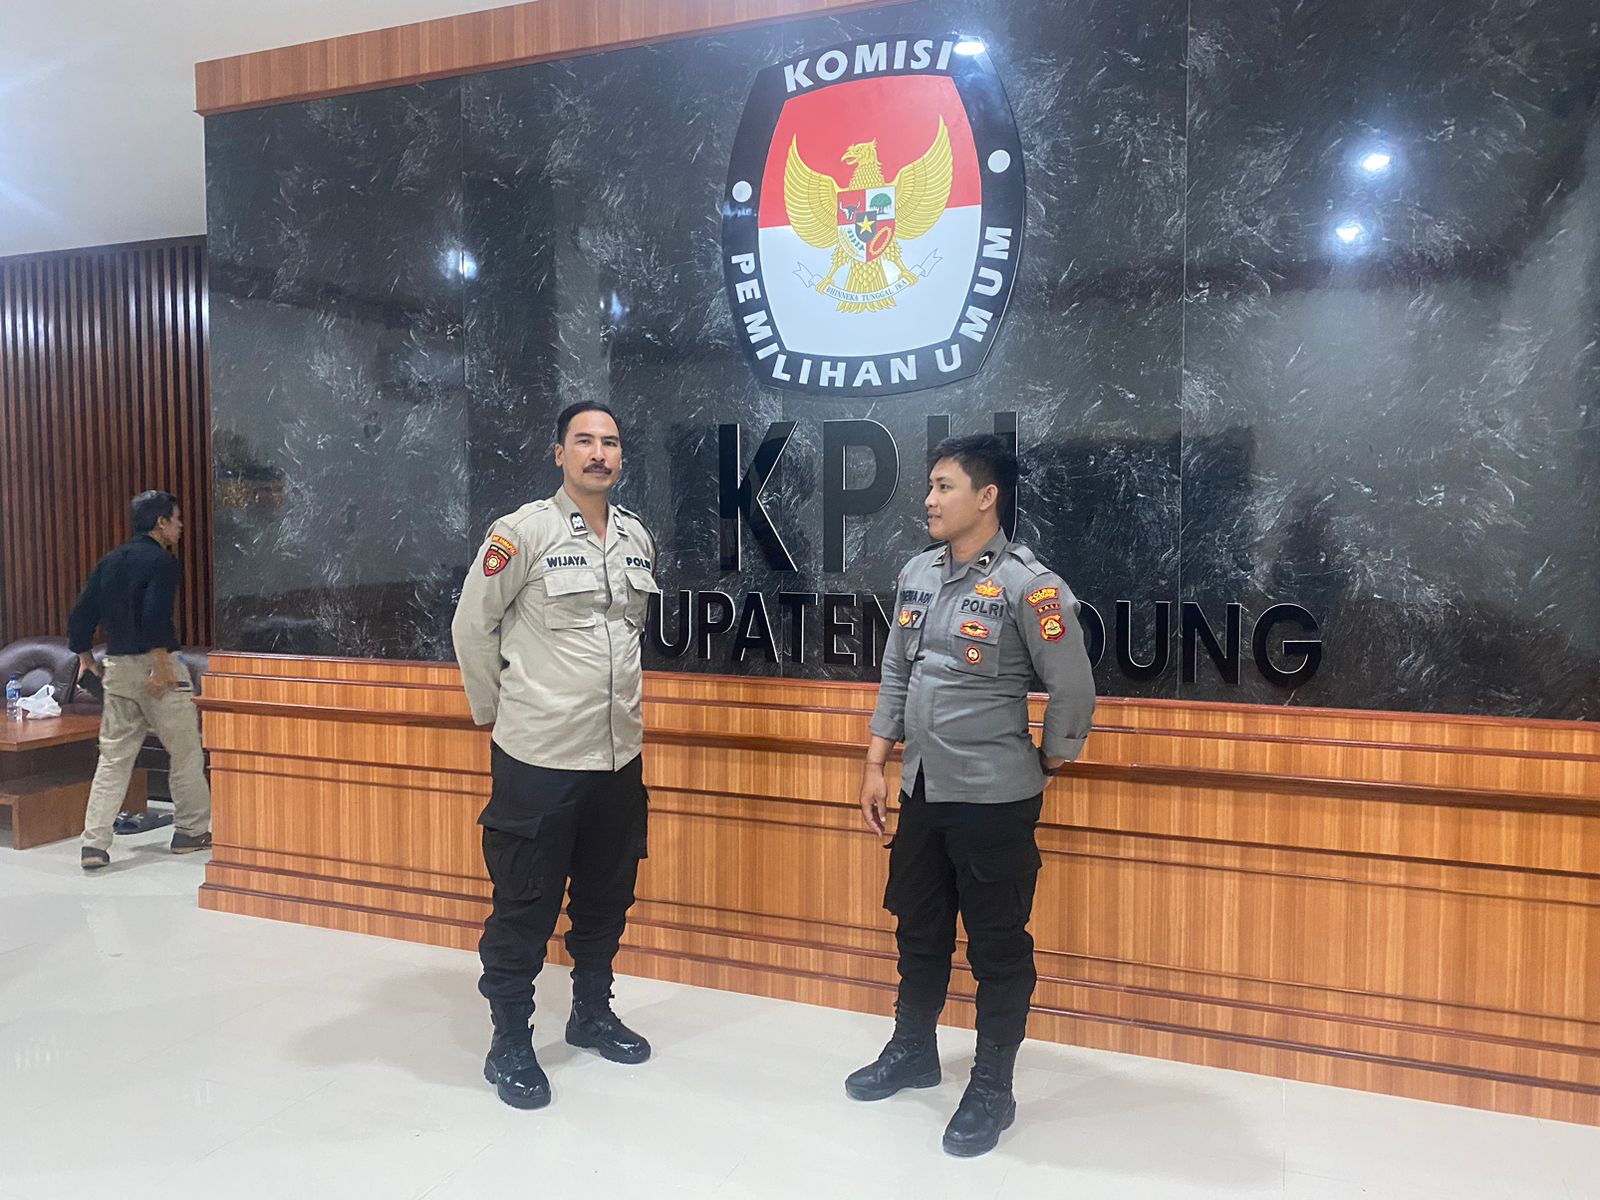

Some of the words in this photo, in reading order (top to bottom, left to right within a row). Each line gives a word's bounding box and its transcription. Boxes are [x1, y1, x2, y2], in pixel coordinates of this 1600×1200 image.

[783, 39, 954, 94] KOMISI
[730, 252, 918, 388] PEMILIHAN
[935, 225, 1013, 373] UMUM
[825, 285, 859, 302] BHINNEKA
[861, 288, 894, 302] TUNGGAL
[894, 279, 908, 291] IKA
[546, 555, 588, 568] WIJAYA
[961, 598, 1004, 618] POLRI
[648, 589, 894, 668] UPATEN
